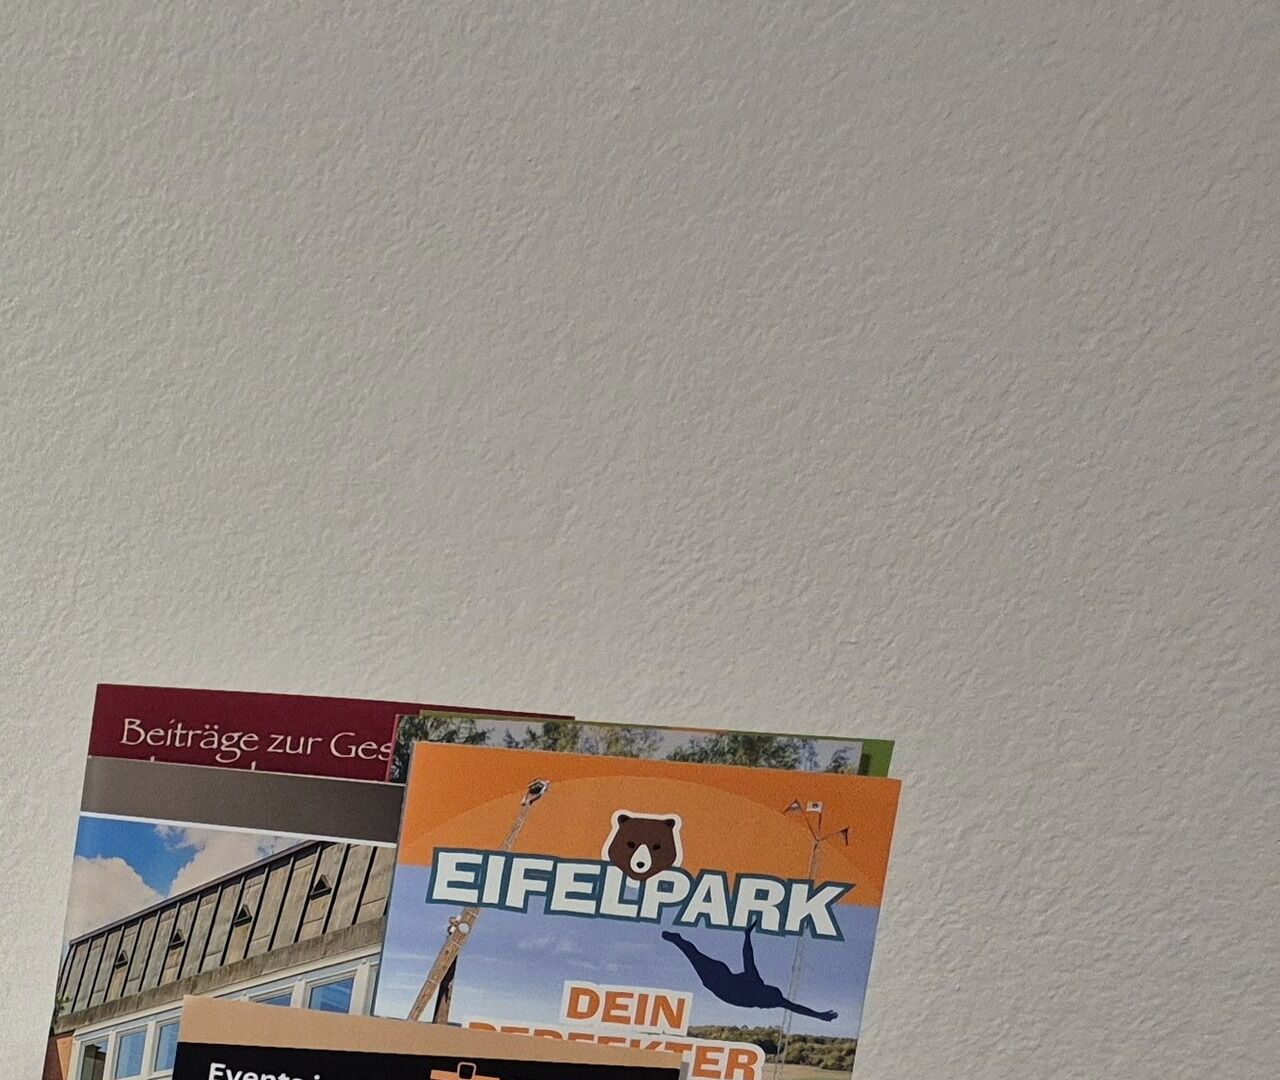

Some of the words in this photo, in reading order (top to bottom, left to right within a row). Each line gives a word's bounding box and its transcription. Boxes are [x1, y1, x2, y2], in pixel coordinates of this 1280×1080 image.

[120, 718, 259, 764] Beiträge
[266, 734, 321, 756] zur
[329, 732, 393, 761] Ges
[426, 847, 854, 941] EIFELPARK
[566, 986, 687, 1032] DEIN
